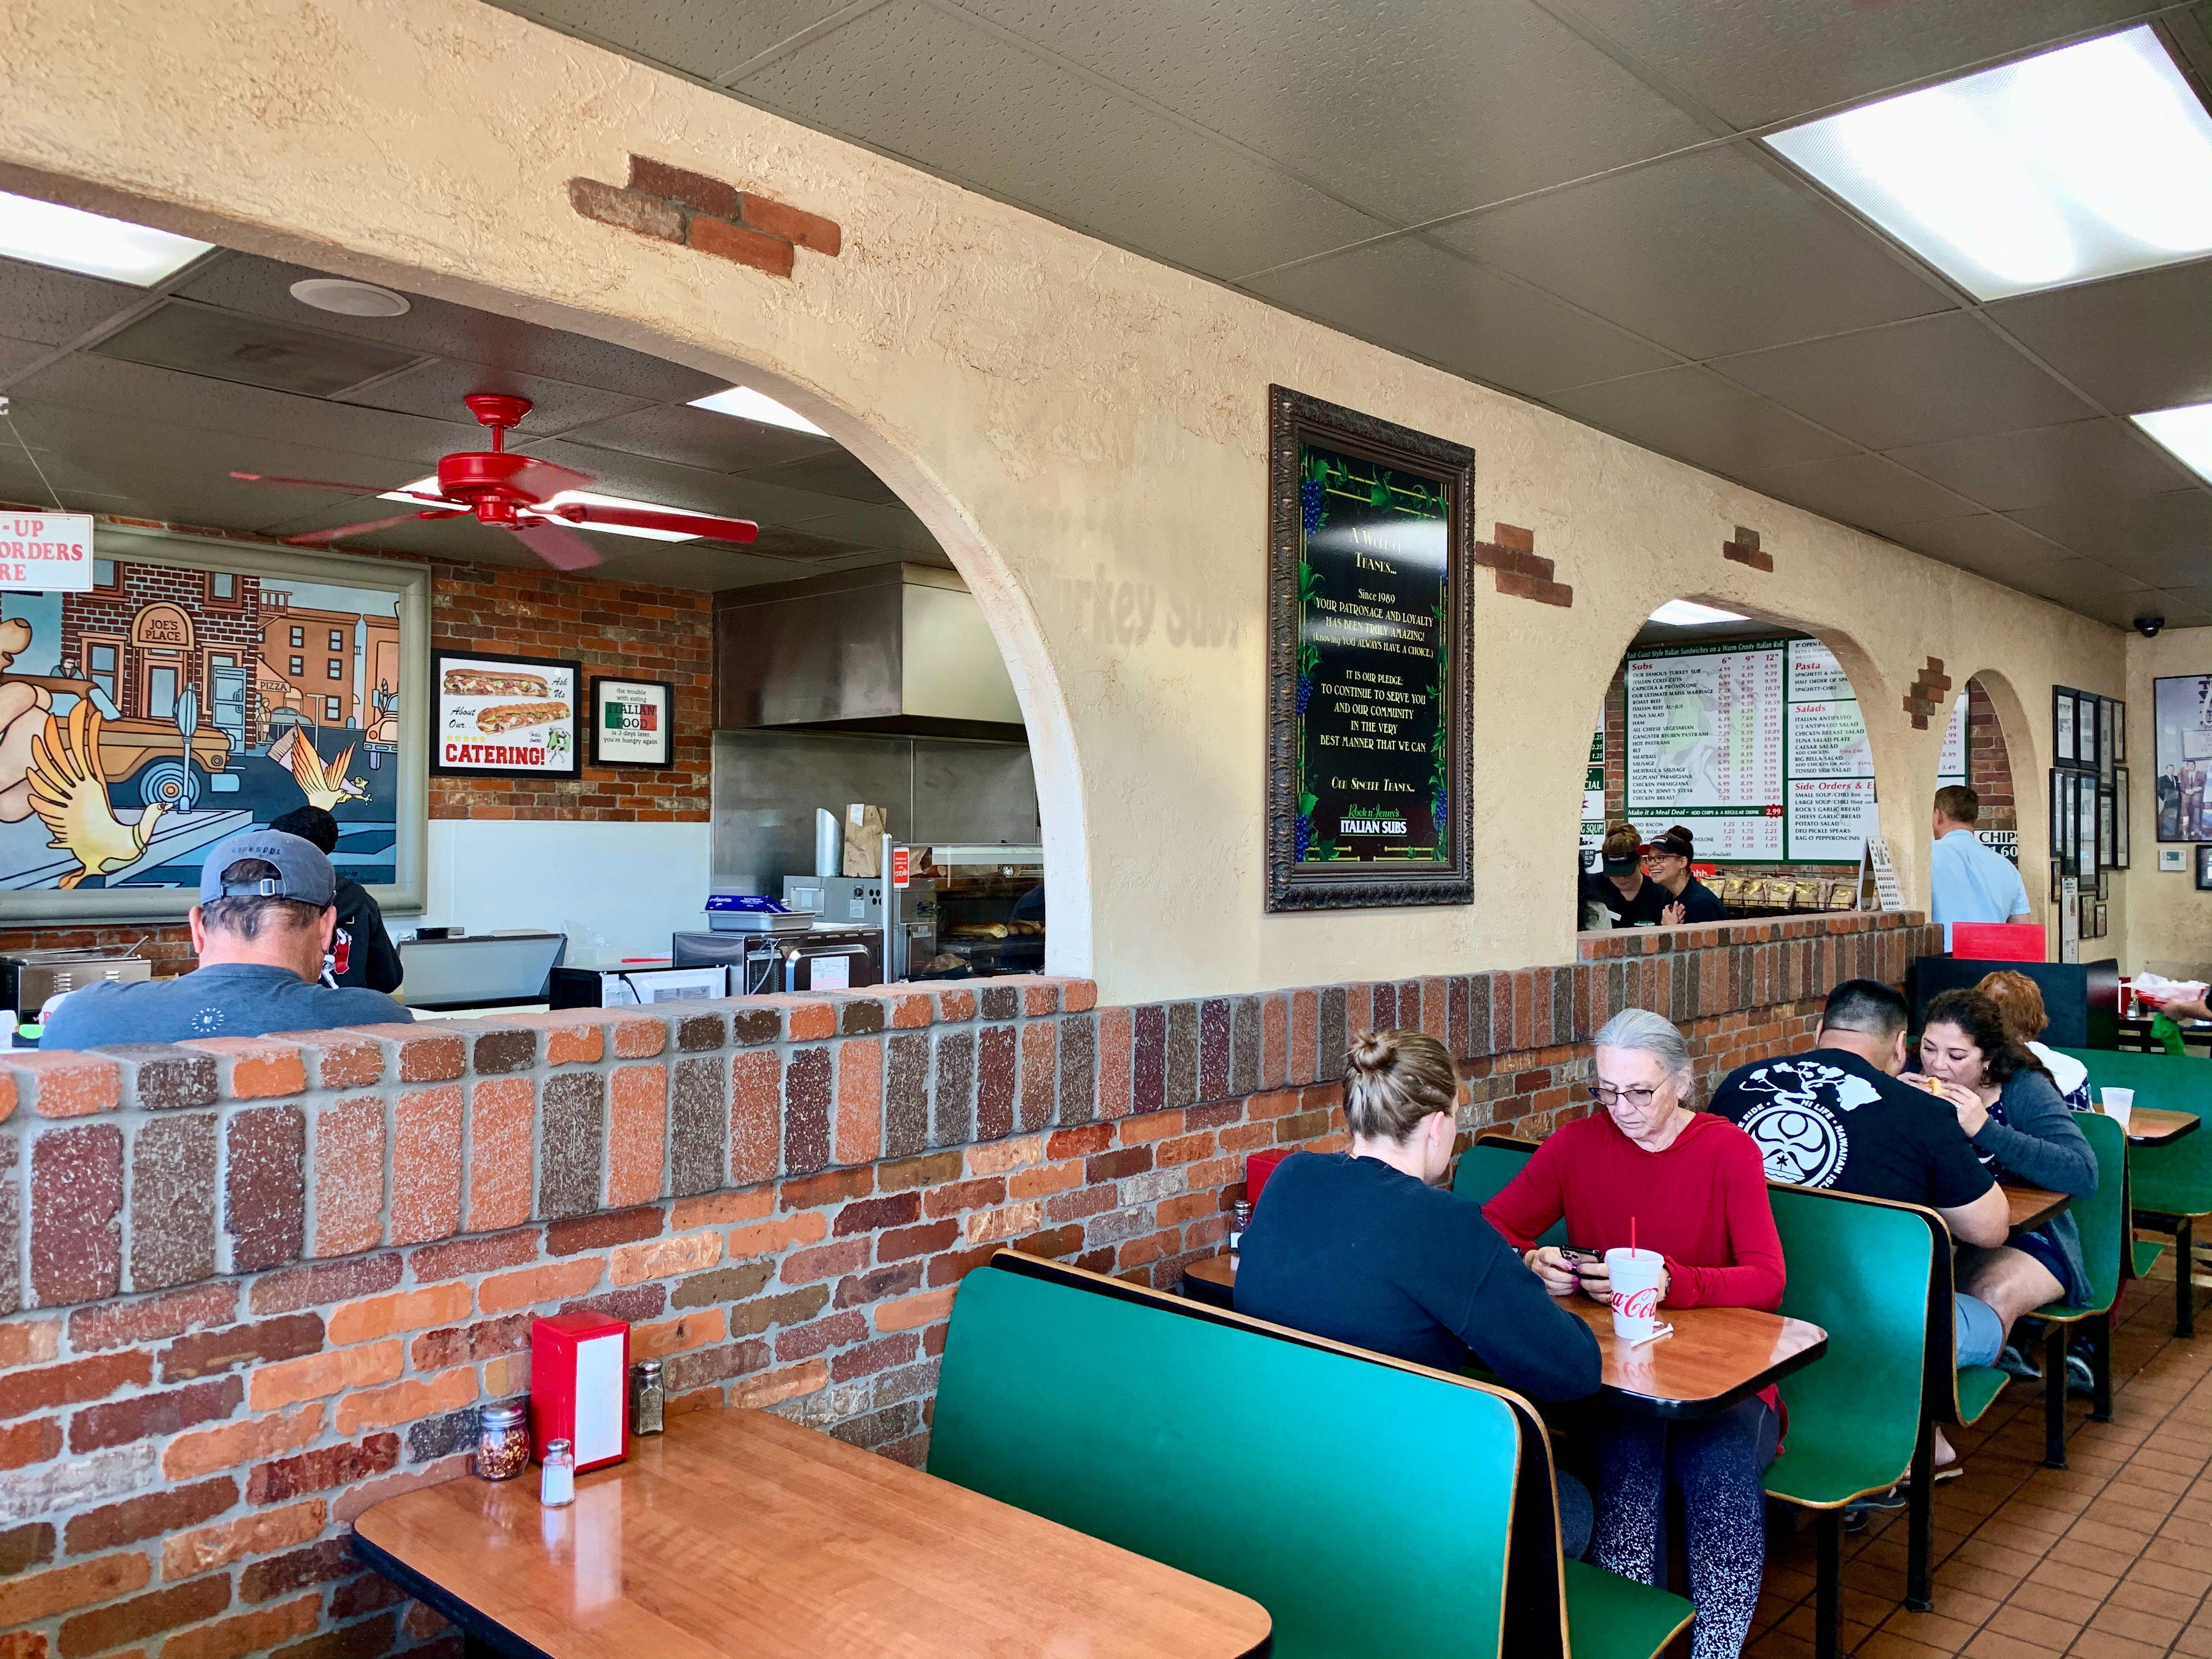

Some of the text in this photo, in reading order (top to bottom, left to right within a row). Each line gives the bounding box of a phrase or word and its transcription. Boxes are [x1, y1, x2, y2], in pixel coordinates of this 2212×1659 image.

[0, 541, 82, 561] ORDERS
[0, 563, 26, 581] RE
[1358, 589, 1395, 603] Since 1989
[1317, 597, 1433, 627] YOUR PATRONAGE AND LOYALTY
[149, 620, 178, 630] JOE'S
[1326, 617, 1425, 641] HAS BEEN TRULY AMAZING!
[145, 630, 180, 641] PLACE
[1342, 636, 1355, 646] YOU
[1357, 640, 1382, 650] ALWAYS
[1384, 643, 1401, 653] HAVE
[1402, 646, 1407, 654] A
[1408, 646, 1433, 658] CHOICE.)
[1681, 646, 1708, 655] Sandwiches
[552, 678, 568, 686] Ask
[1346, 670, 1403, 685] IT IS OUR PLEDGE:
[260, 682, 287, 691] PIZZA
[1321, 683, 1426, 704] TO CONTINUE TO SERVE YOU
[450, 707, 476, 716] About
[608, 704, 655, 715] ITALIAN
[1334, 702, 1414, 719] AND OUR COMMUNITY
[1796, 704, 1826, 713] Salads
[449, 719, 475, 729] Our...
[616, 718, 647, 729] FOOD
[1351, 720, 1397, 735] IN THE VERY
[1321, 735, 1426, 752] BEST MANNER THAT WE CAN
[446, 744, 545, 765] CATERING!
[1585, 781, 1600, 789] CIAL
[1348, 804, 1369, 818] Rock
[1373, 804, 1400, 821] Jenny's
[1341, 820, 1407, 833] ITALIAN SUBS
[1742, 1103, 1765, 1121] RIDE
[1801, 1099, 1835, 1119] HI LIFE
[1818, 1125, 1848, 1189] HAWAIIAN ISL
